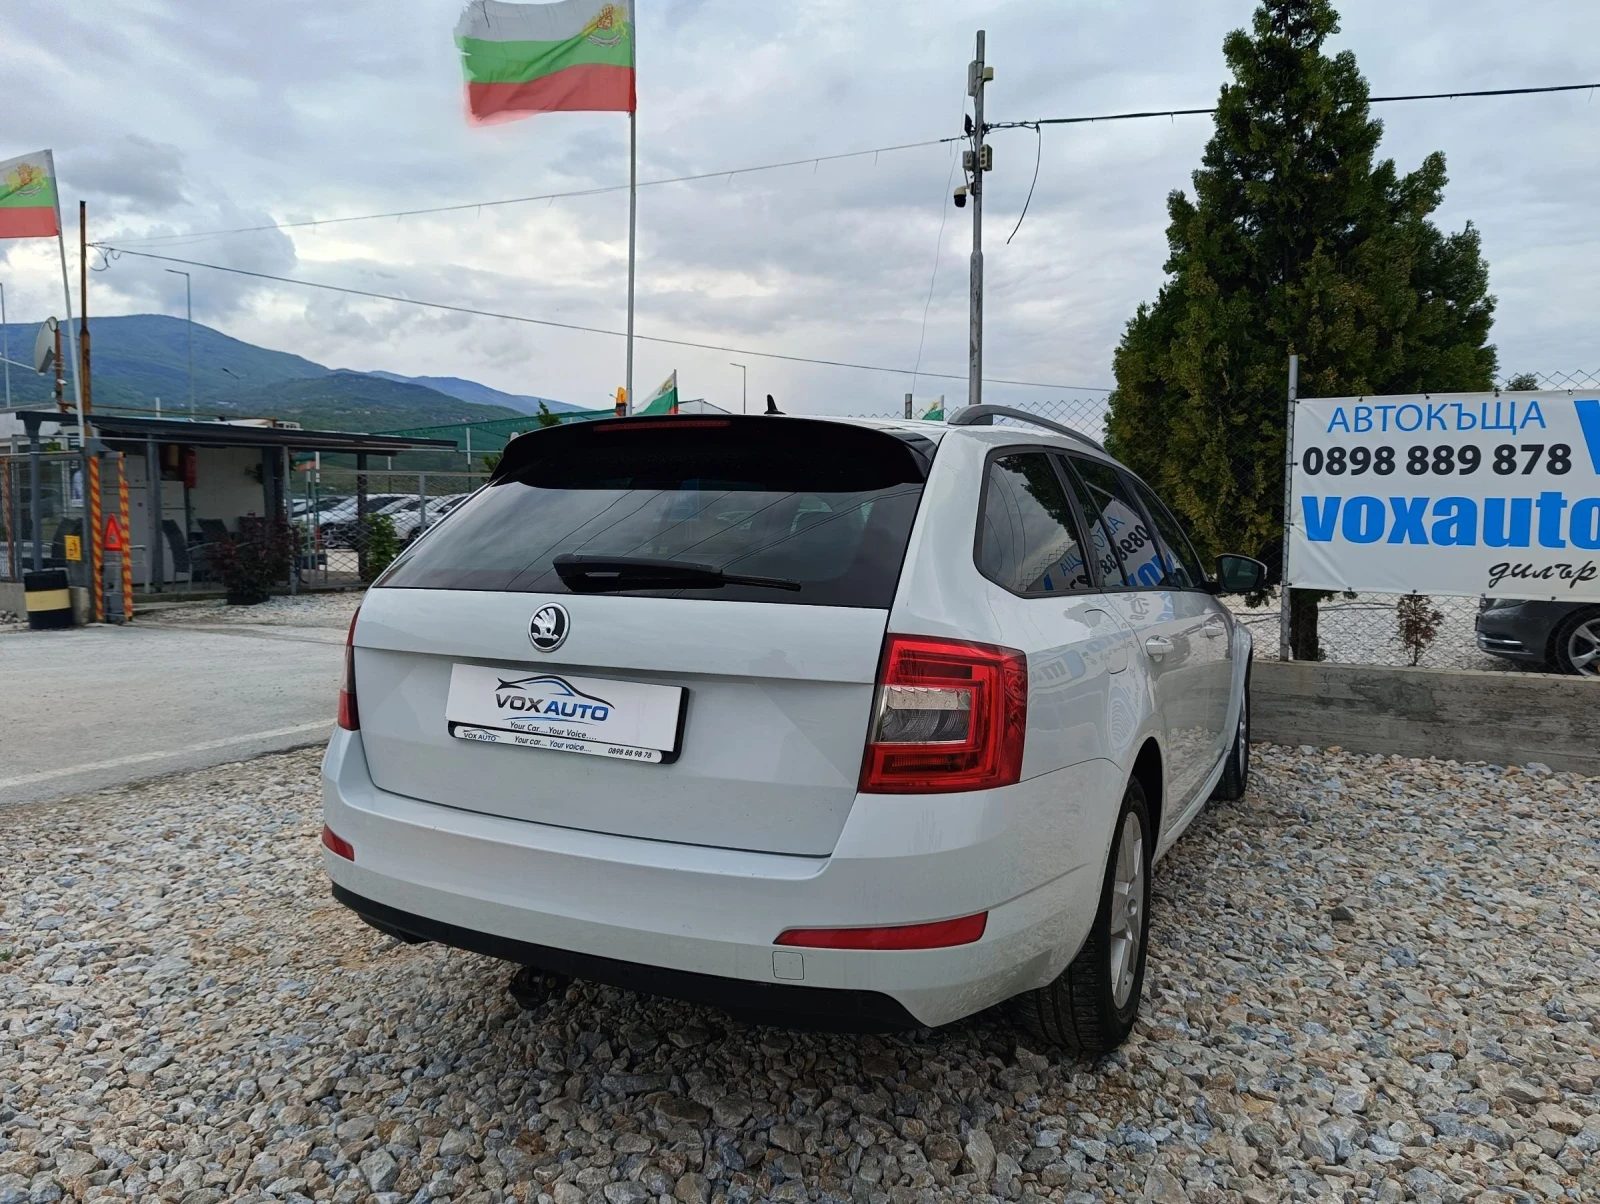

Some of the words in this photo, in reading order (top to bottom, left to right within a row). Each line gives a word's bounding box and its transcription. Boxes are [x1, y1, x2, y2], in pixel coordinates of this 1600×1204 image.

[1326, 400, 1547, 435] АВТОКЪЩА
[1302, 446, 1396, 476] 0898
[1405, 444, 1482, 476] 889
[1491, 443, 1572, 476] 878
[1301, 491, 1600, 550] voxauto
[1488, 560, 1599, 588] дилър
[496, 693, 544, 713] VOX
[543, 700, 609, 722] AUTO
[464, 732, 477, 740] VOX
[478, 734, 496, 742] AUTO
[510, 721, 526, 730] Your
[514, 735, 529, 744] Your
[549, 740, 564, 749] Your
